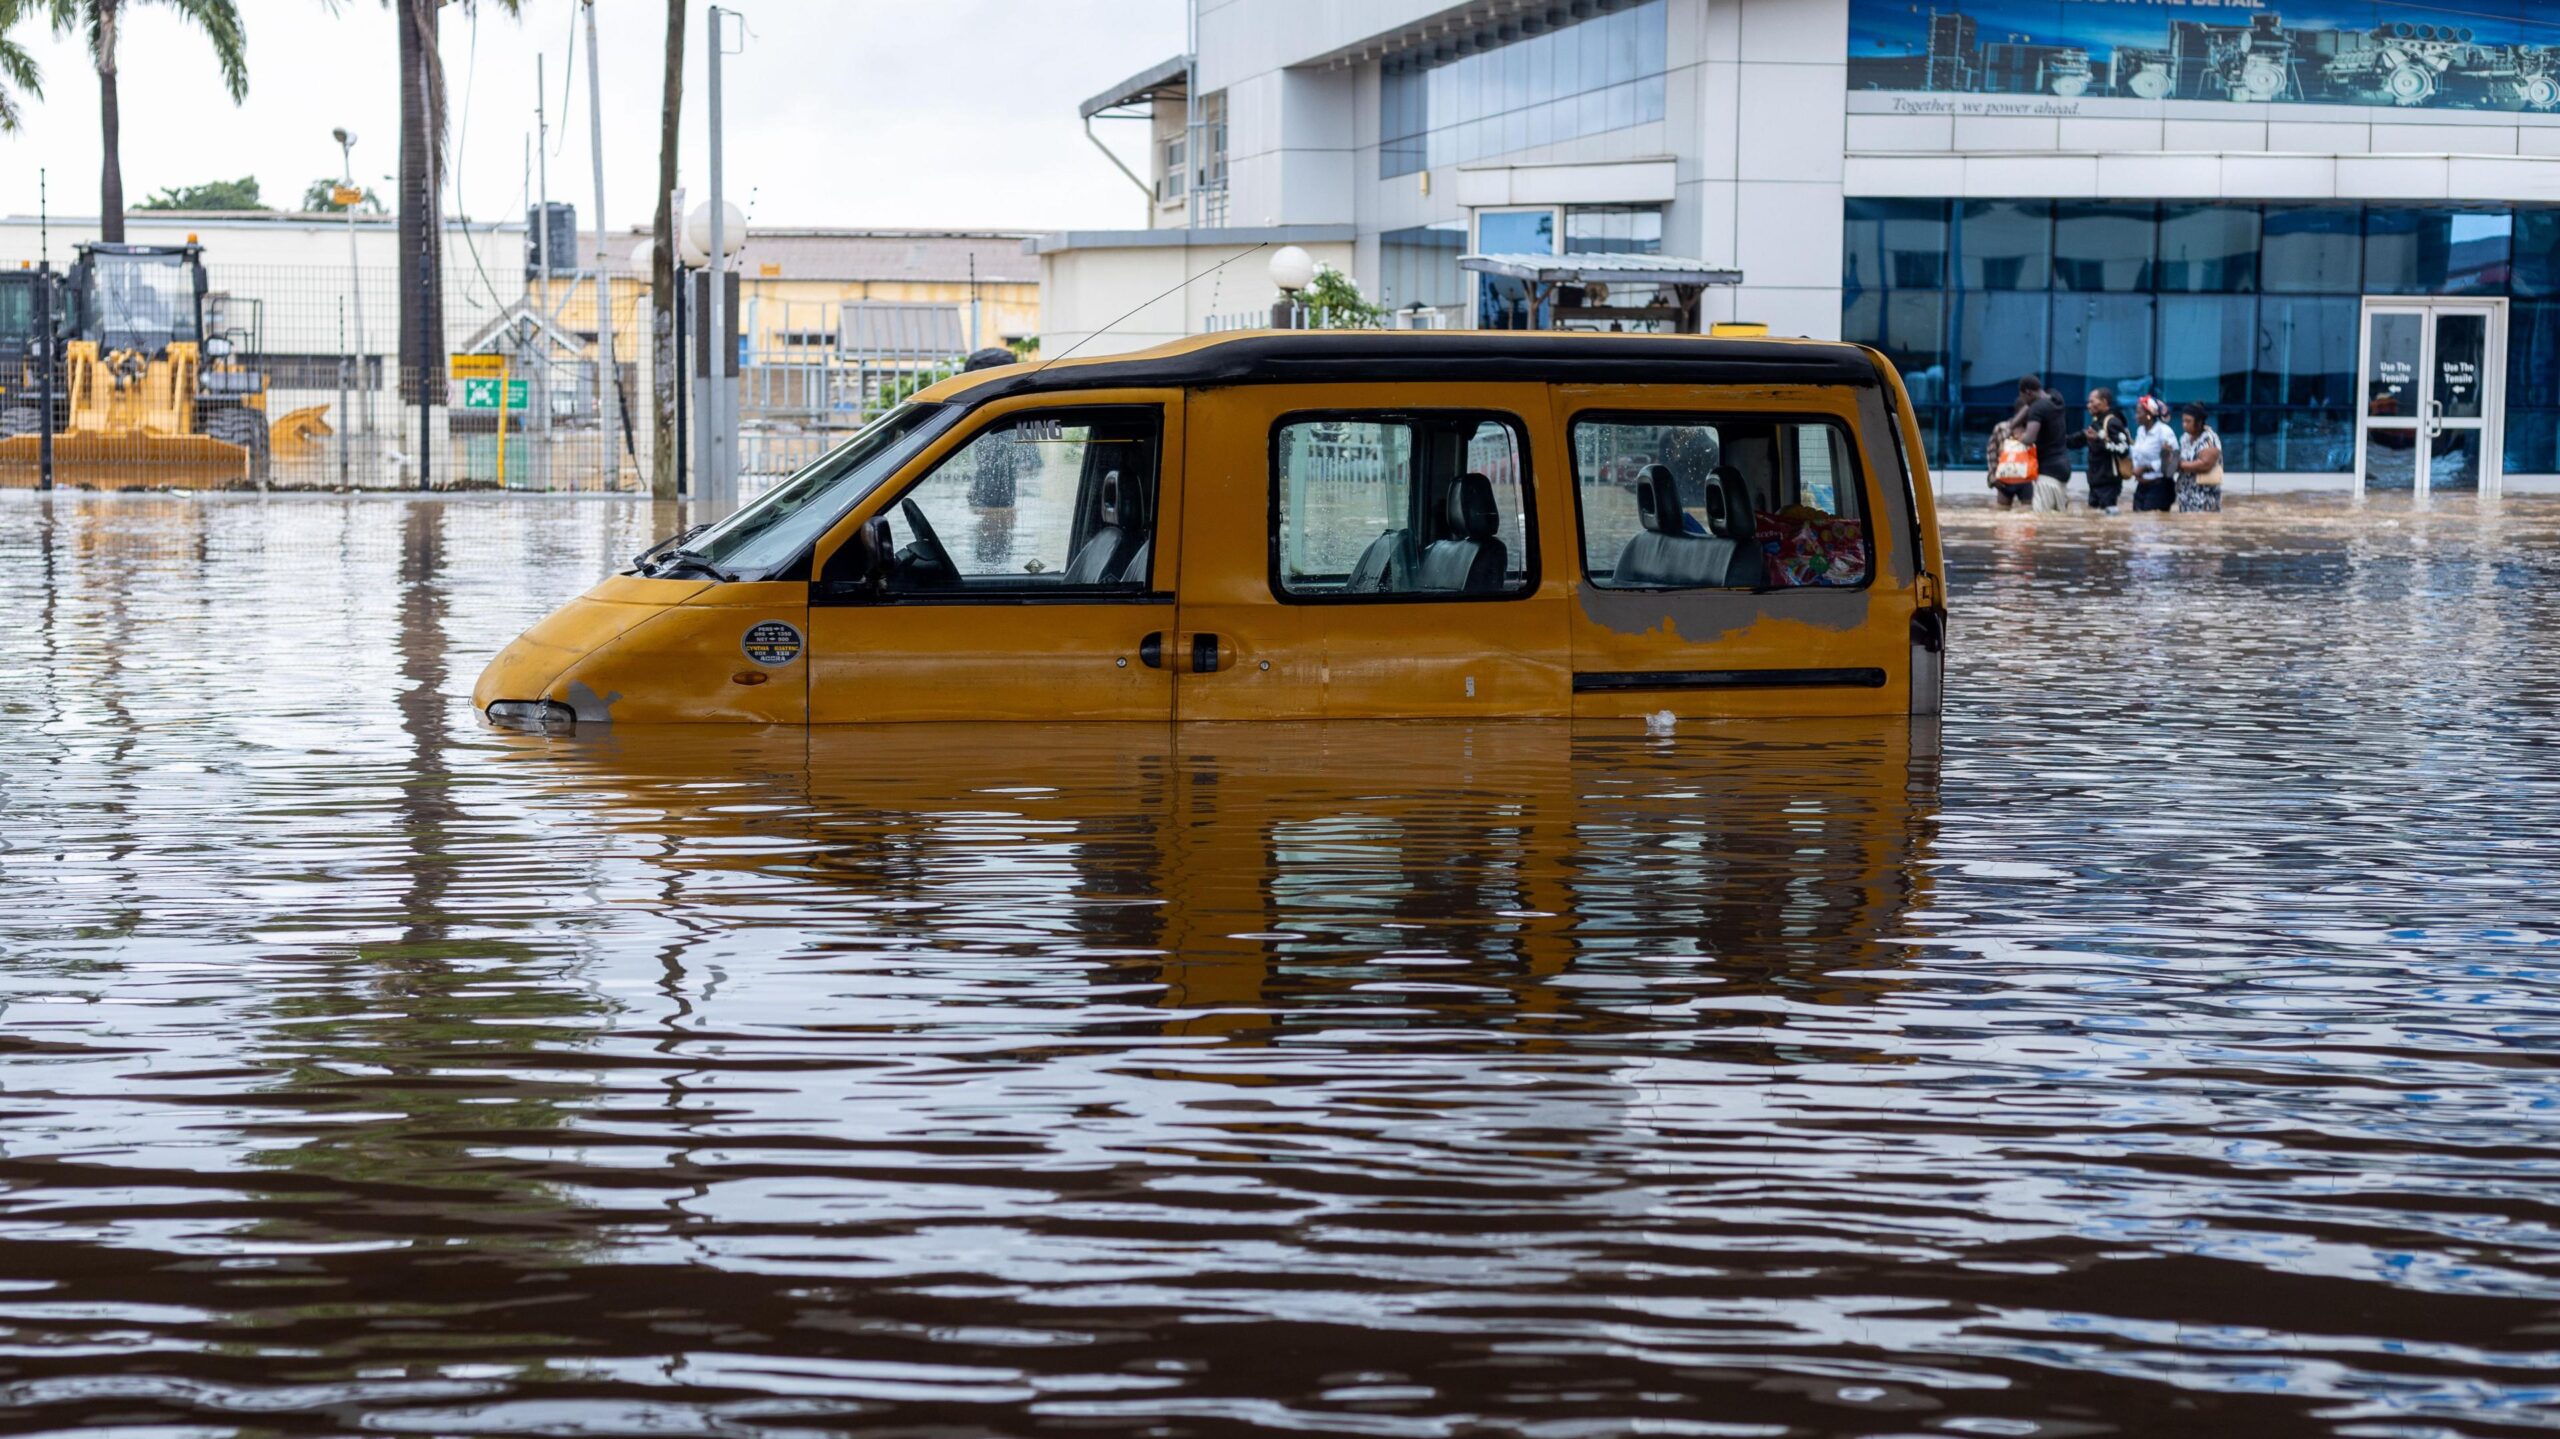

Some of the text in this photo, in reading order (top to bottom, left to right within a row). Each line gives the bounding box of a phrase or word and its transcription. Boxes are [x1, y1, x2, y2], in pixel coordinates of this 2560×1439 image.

[1892, 97, 2081, 116] Together, we power ahead.
[2380, 361, 2411, 372] Use The
[2443, 361, 2475, 372] Use The
[1016, 419, 1063, 440] KING
